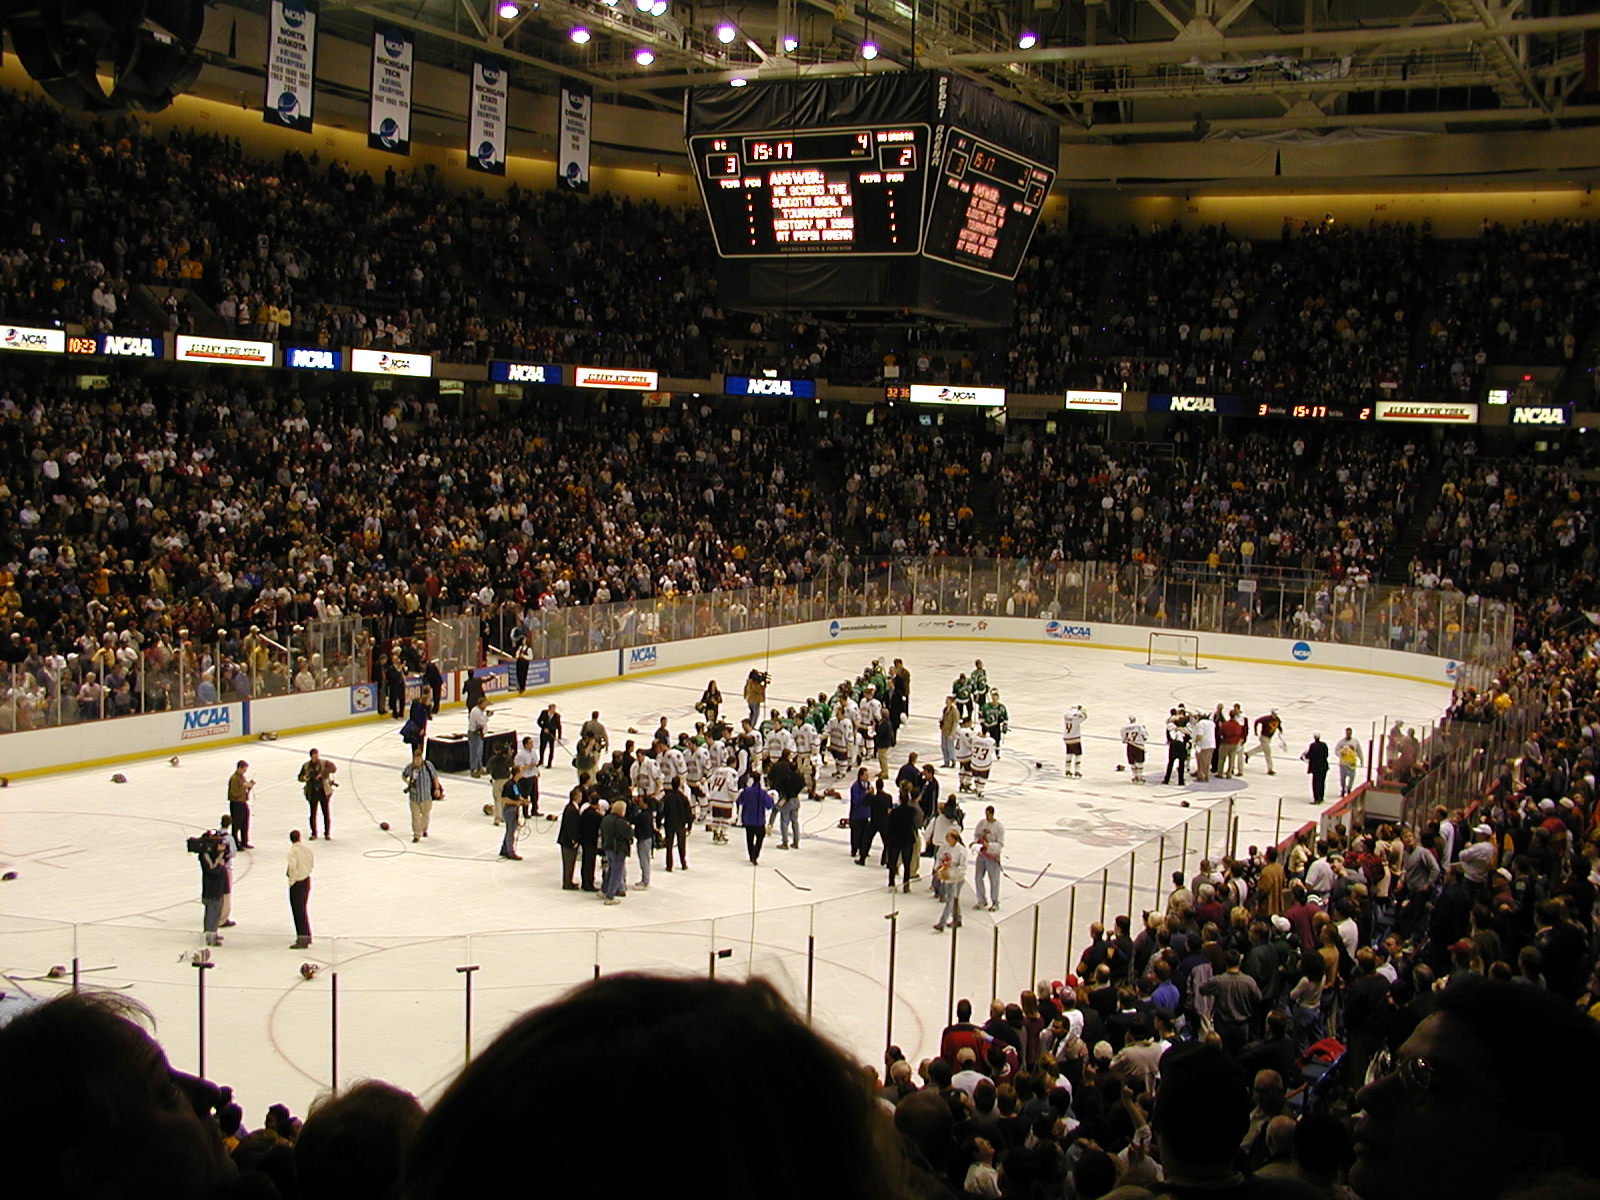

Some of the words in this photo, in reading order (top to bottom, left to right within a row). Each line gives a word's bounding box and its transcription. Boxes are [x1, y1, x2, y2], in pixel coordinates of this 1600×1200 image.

[280, 27, 305, 41] NORTH
[277, 36, 307, 52] DAKOTA
[377, 56, 410, 72] MICHIGAN
[384, 67, 401, 79] TECH
[476, 84, 505, 98] MICHIGAN
[937, 76, 948, 118] PEPSI
[481, 94, 498, 105] STATE
[857, 133, 868, 149] 4
[931, 124, 944, 167] ARENA
[752, 143, 793, 160] 15:17
[899, 149, 912, 166] 2
[726, 156, 737, 173] 3
[769, 170, 825, 186] ANSWER:
[773, 185, 787, 197] HE
[789, 184, 825, 196] SCORED
[827, 182, 847, 195] THE
[813, 195, 839, 207] GOAL
[841, 194, 852, 207] IN
[781, 207, 843, 219] TOURNAMENT
[773, 218, 814, 231] HISTORY
[815, 218, 827, 229] IN
[776, 230, 790, 241] AT
[792, 229, 820, 241] PEPSI
[821, 229, 853, 241] ARENA
[21, 333, 47, 345] NCAA
[104, 335, 153, 356] NCAA
[293, 349, 333, 369] NCAA
[508, 364, 544, 382] NCAA
[747, 378, 792, 396] NCAA
[1170, 395, 1215, 411] NCAA
[1389, 406, 1419, 415] ALBANY
[1424, 407, 1441, 415] NEW
[1258, 404, 1268, 416] 3
[1292, 405, 1327, 417] 15:17
[1360, 407, 1370, 420] 2
[1513, 407, 1563, 424] NCAA
[1063, 625, 1091, 635] NCAA
[631, 646, 656, 663] NCAA
[183, 706, 230, 730] NCAA
[711, 777, 726, 791] 14
